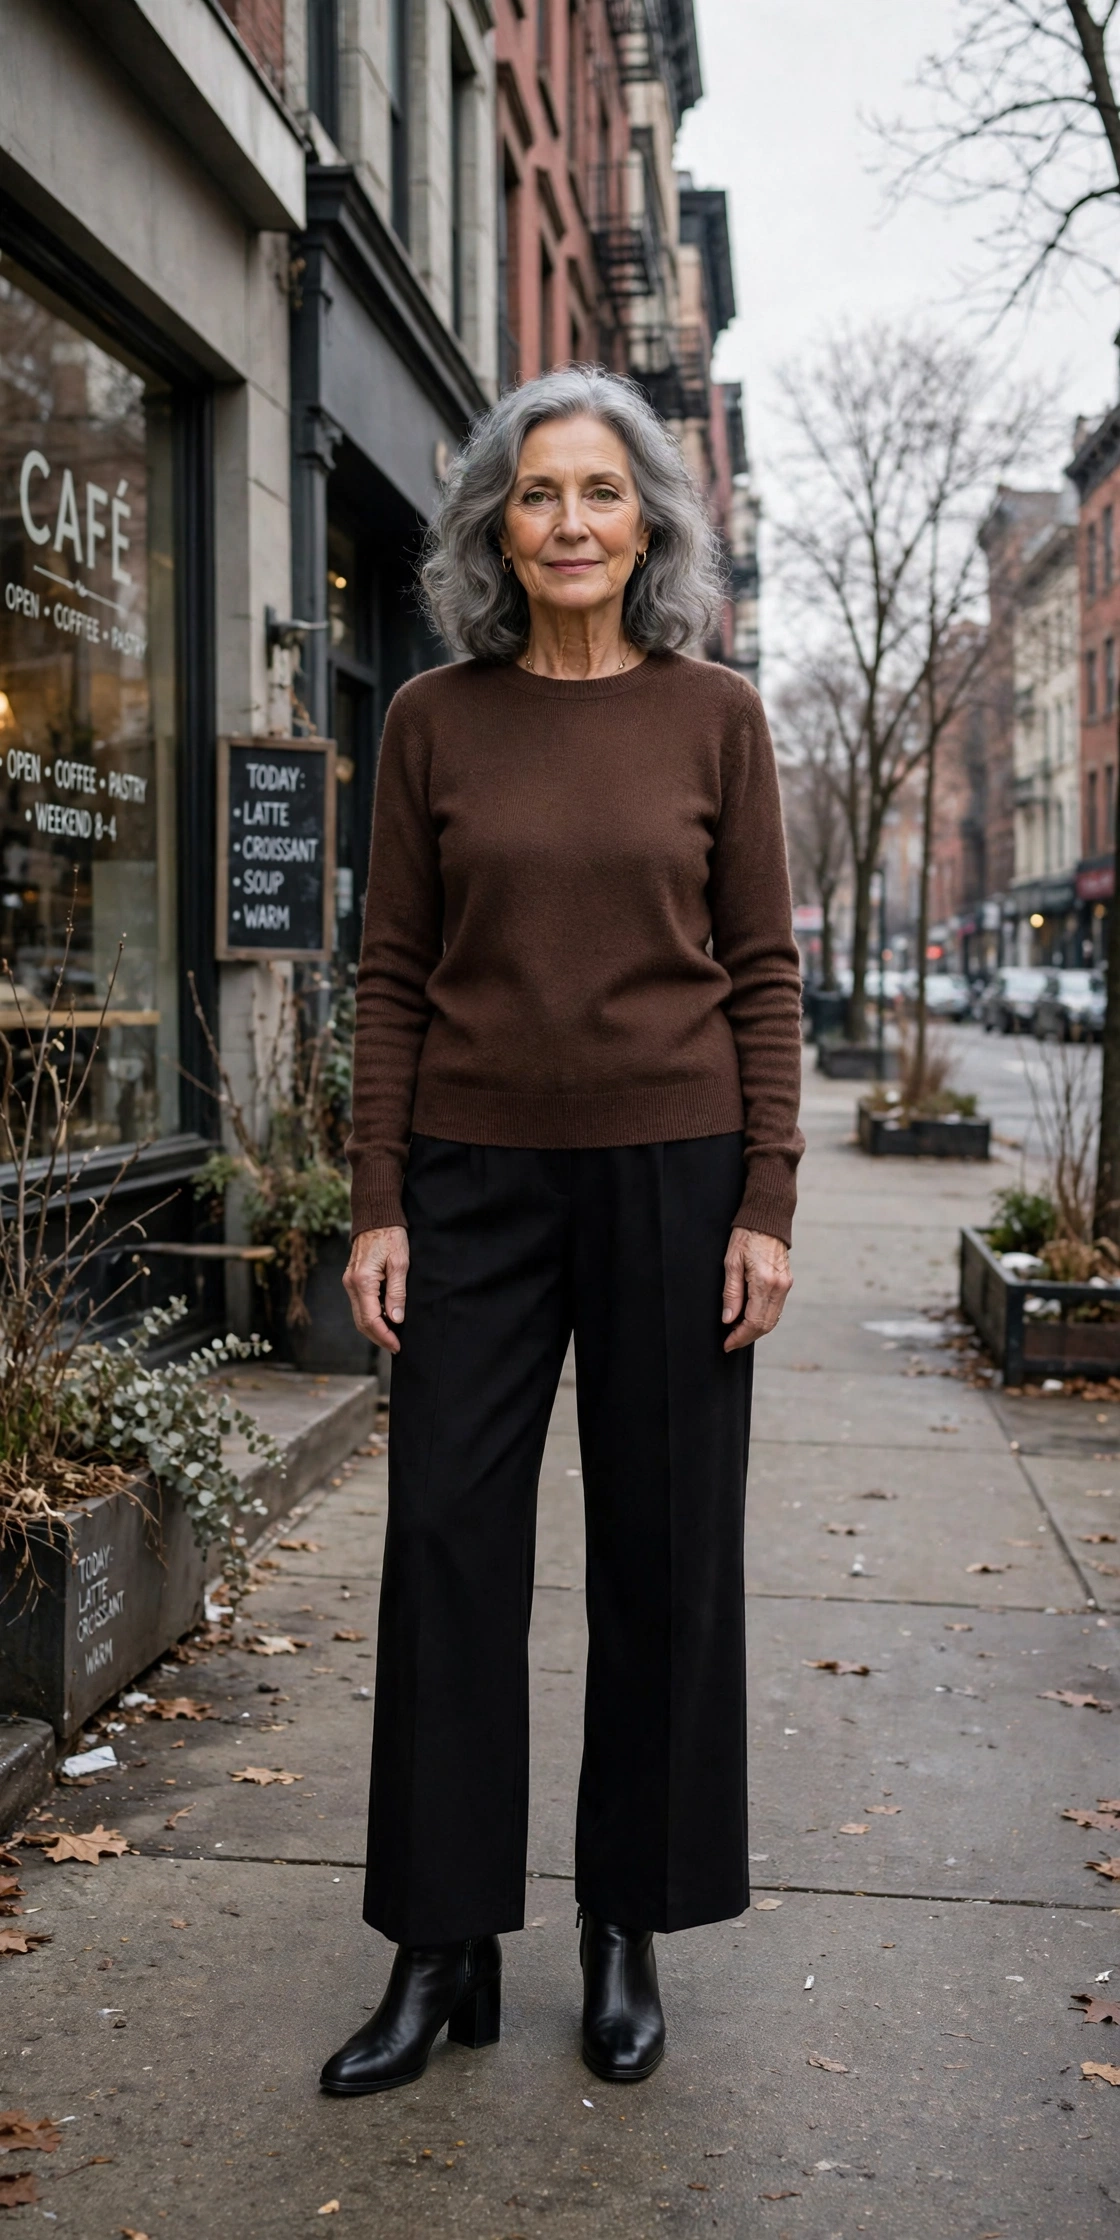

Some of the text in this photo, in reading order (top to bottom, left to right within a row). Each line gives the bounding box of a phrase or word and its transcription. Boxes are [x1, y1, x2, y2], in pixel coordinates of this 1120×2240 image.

[20, 449, 132, 586] CAFÉ
[5, 582, 39, 619] OPEN
[7, 748, 148, 804] OPEN COFFEE PASTRY
[246, 763, 306, 792] TODAY:
[35, 801, 117, 842] WEEKEND 8-4
[243, 801, 290, 827] LATTE
[242, 835, 319, 862] CROISSANT
[243, 869, 284, 895] SOUP
[243, 903, 290, 930] WARM
[78, 1577, 108, 1614] LATTE
[85, 1638, 113, 1676] WARM
